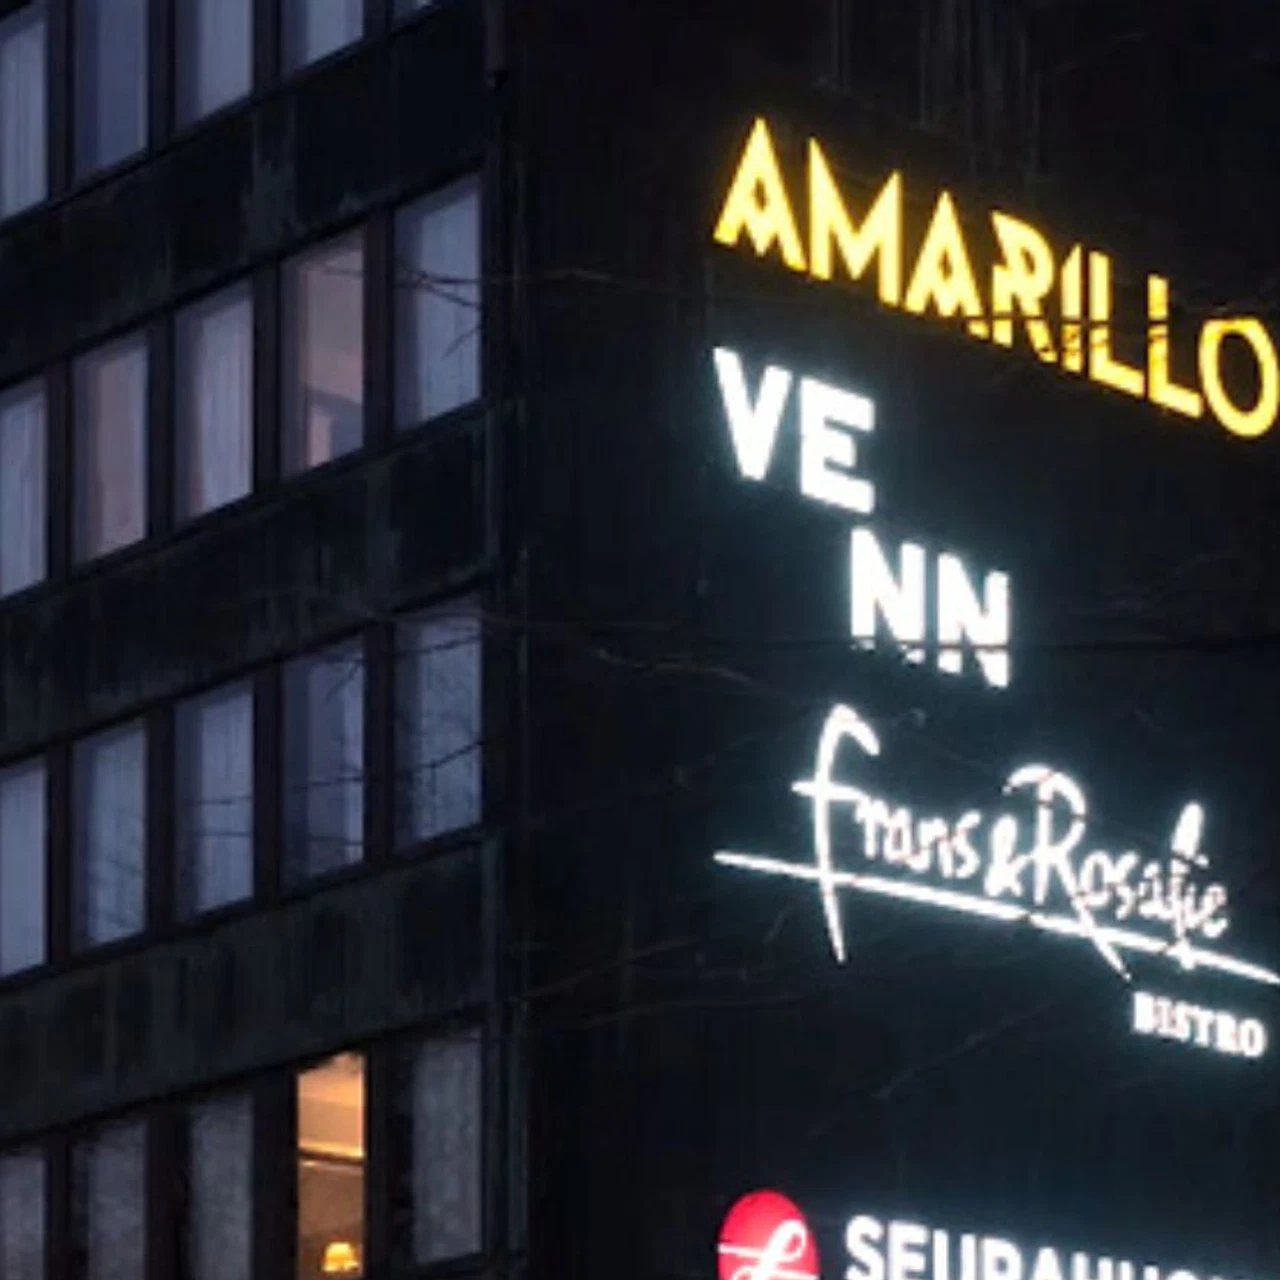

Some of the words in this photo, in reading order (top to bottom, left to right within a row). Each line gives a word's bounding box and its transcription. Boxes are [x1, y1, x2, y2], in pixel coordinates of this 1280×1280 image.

[714, 115, 1280, 438] AMARILLO
[713, 346, 875, 515] VE
[850, 526, 1009, 688] NN
[1132, 991, 1267, 1059] BISTRO
